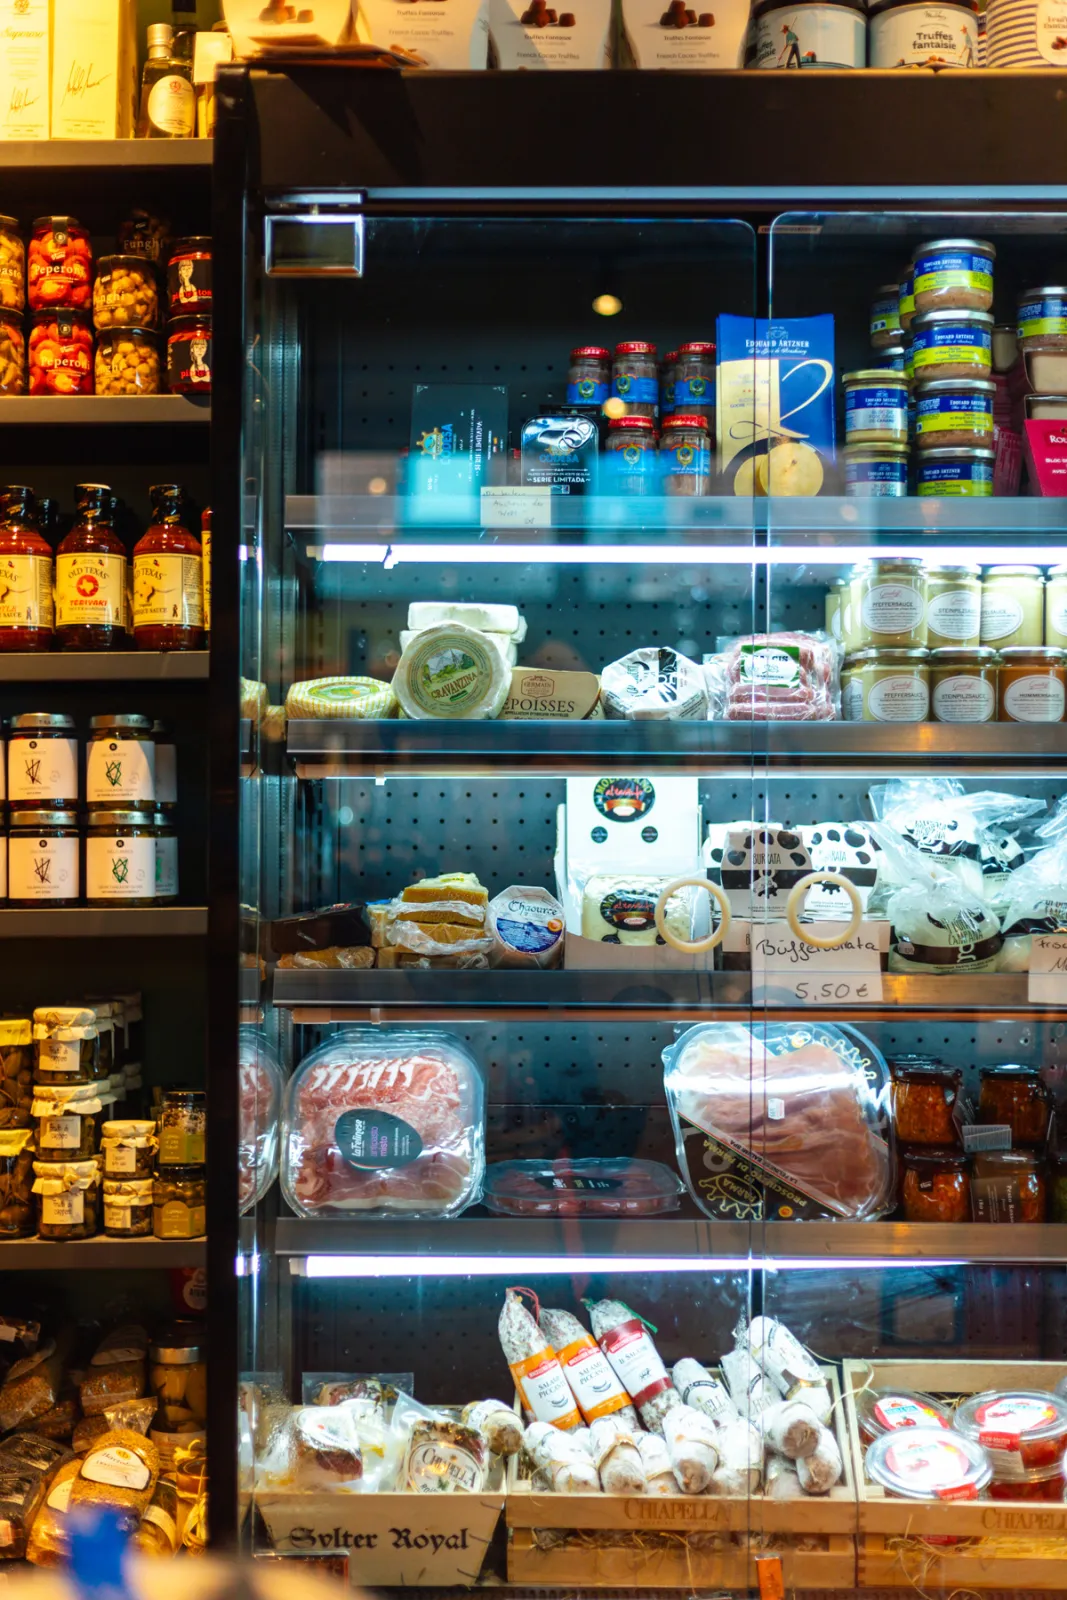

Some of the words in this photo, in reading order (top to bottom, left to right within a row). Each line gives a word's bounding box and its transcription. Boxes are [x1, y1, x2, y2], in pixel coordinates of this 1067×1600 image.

[916, 31, 953, 41] Truffes
[912, 40, 957, 50] fantaisie
[124, 238, 163, 251] Funghi
[35, 264, 86, 276] Peperoni
[779, 339, 810, 348] ARTZNER
[41, 358, 90, 371] Peperoni
[539, 454, 580, 463] CODESA
[0, 570, 19, 582] EXAS
[68, 568, 84, 580] OLD
[85, 567, 108, 580] TEXAS
[142, 568, 163, 581] TEXAS
[508, 900, 562, 917] Chaource
[755, 937, 880, 963] Büffeata
[795, 982, 849, 1001] 5,50
[856, 983, 869, 998] €
[379, 1135, 388, 1157] misto
[703, 1139, 736, 1164] PARMA
[736, 1160, 749, 1172] DI
[723, 1178, 757, 1203] PARMA
[578, 1361, 603, 1377] SALAME
[624, 1498, 728, 1522] CHIAPELLA
[981, 1507, 1067, 1531] CHIAPELL
[289, 1526, 378, 1550] Sylter
[388, 1527, 469, 1556] Royal
